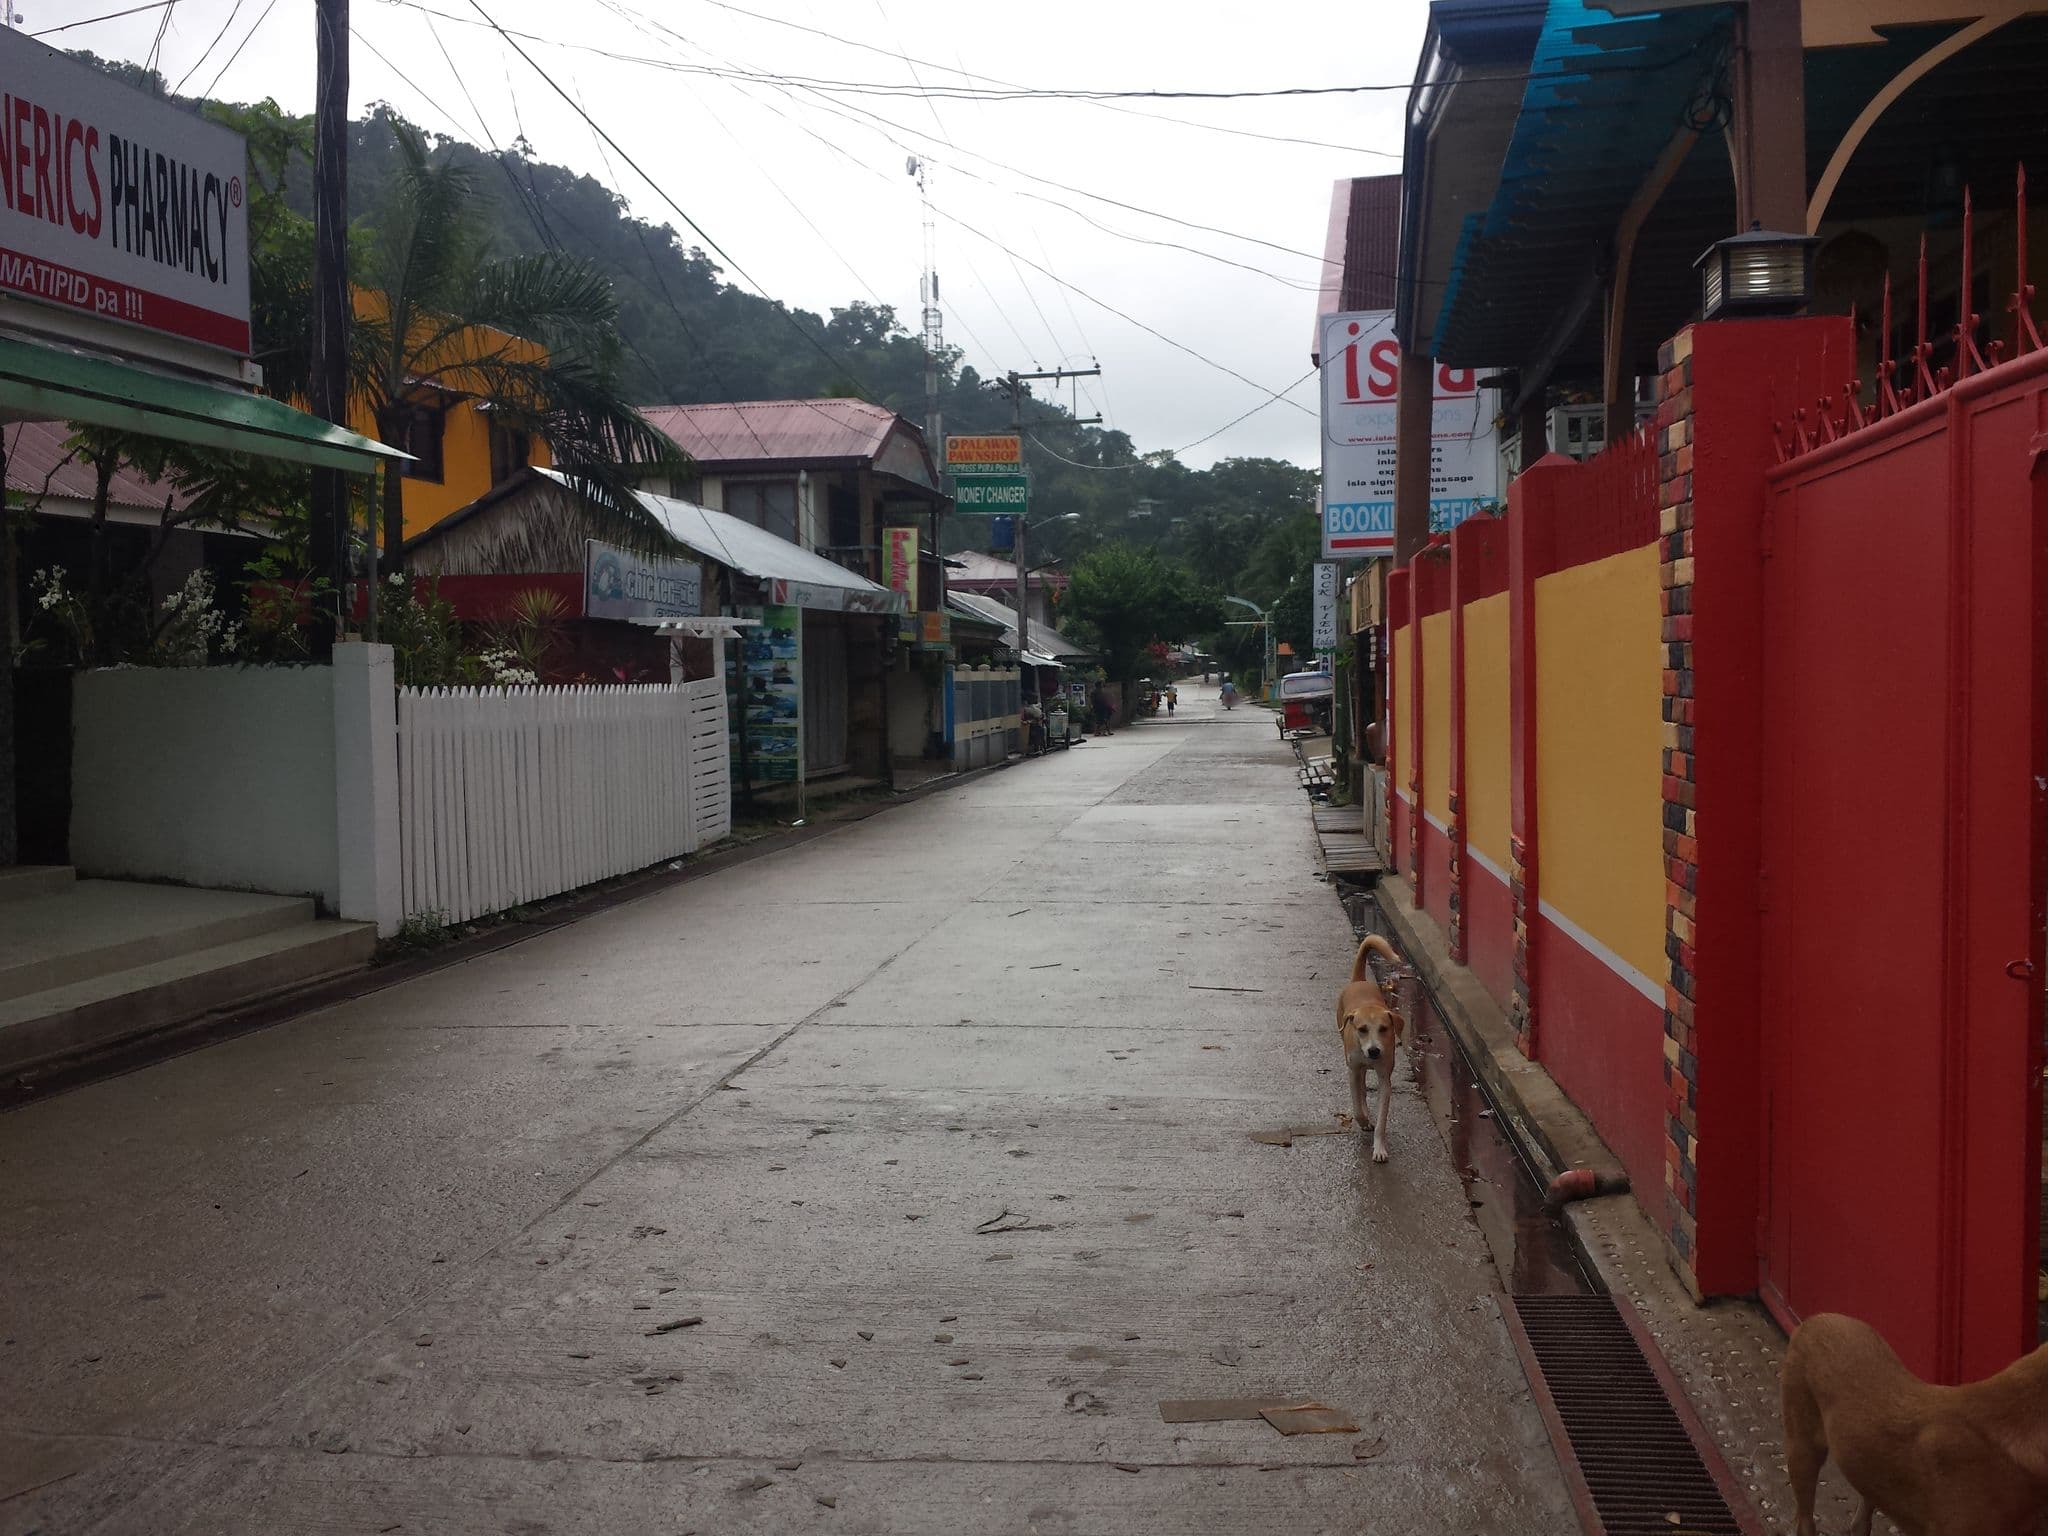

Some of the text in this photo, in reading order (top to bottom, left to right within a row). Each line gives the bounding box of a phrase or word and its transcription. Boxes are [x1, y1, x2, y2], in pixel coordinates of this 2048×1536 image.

[1, 255, 90, 304] MATIPID
[95, 287, 118, 313] pa
[1346, 322, 1475, 399] isa
[961, 439, 1018, 449] PALAWAN
[949, 451, 1018, 461] PAWNSHOP
[957, 486, 1025, 504] MONEY CHANGER
[1328, 505, 1394, 532] BOOKI
